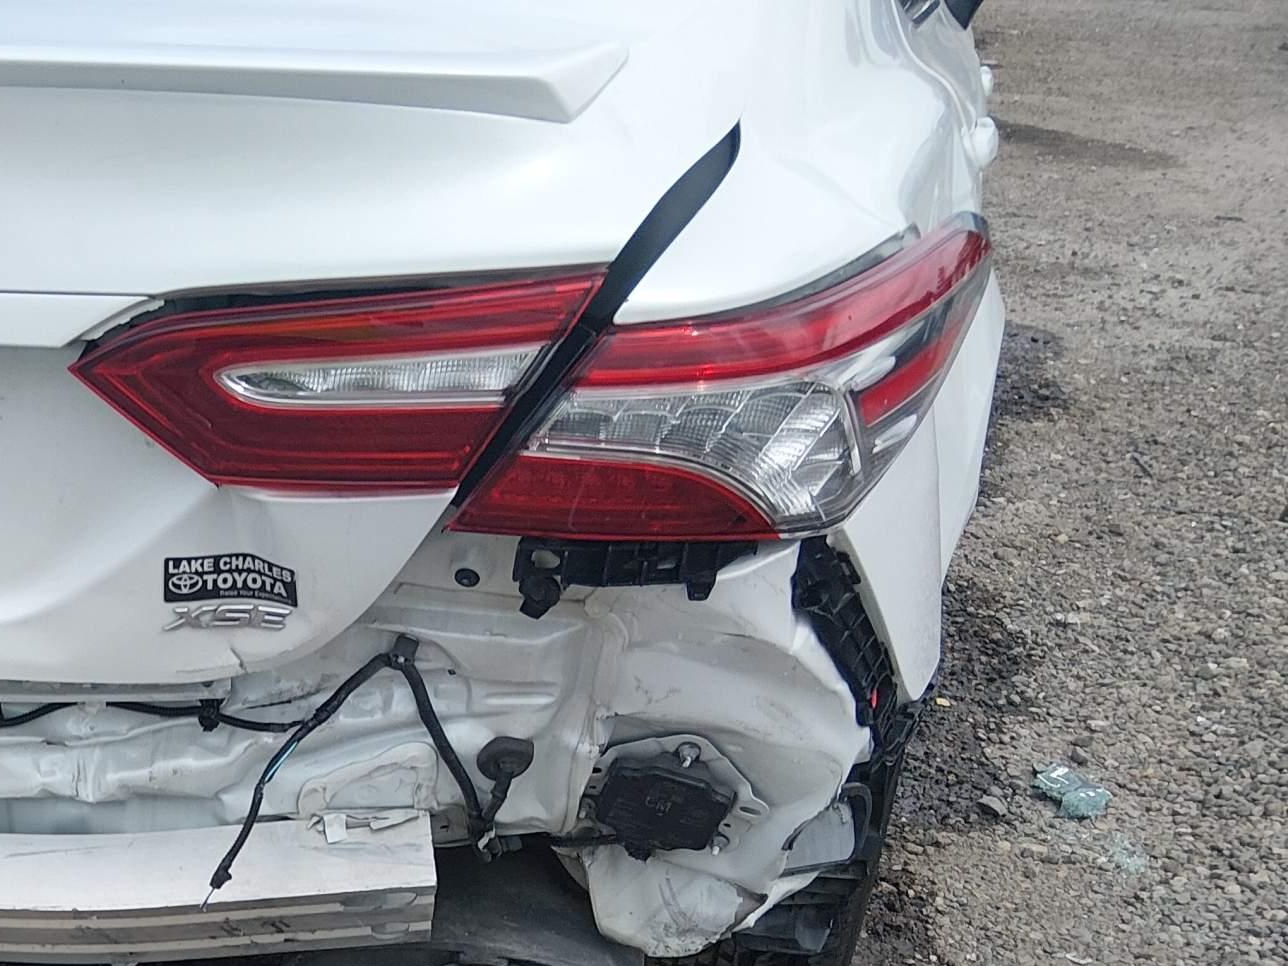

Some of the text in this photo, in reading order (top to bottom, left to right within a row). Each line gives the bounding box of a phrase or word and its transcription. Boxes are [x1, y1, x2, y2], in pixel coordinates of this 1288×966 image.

[168, 556, 292, 583] LAKE CHARLES
[203, 571, 288, 598] TOYOTA
[164, 604, 292, 632] XSE
